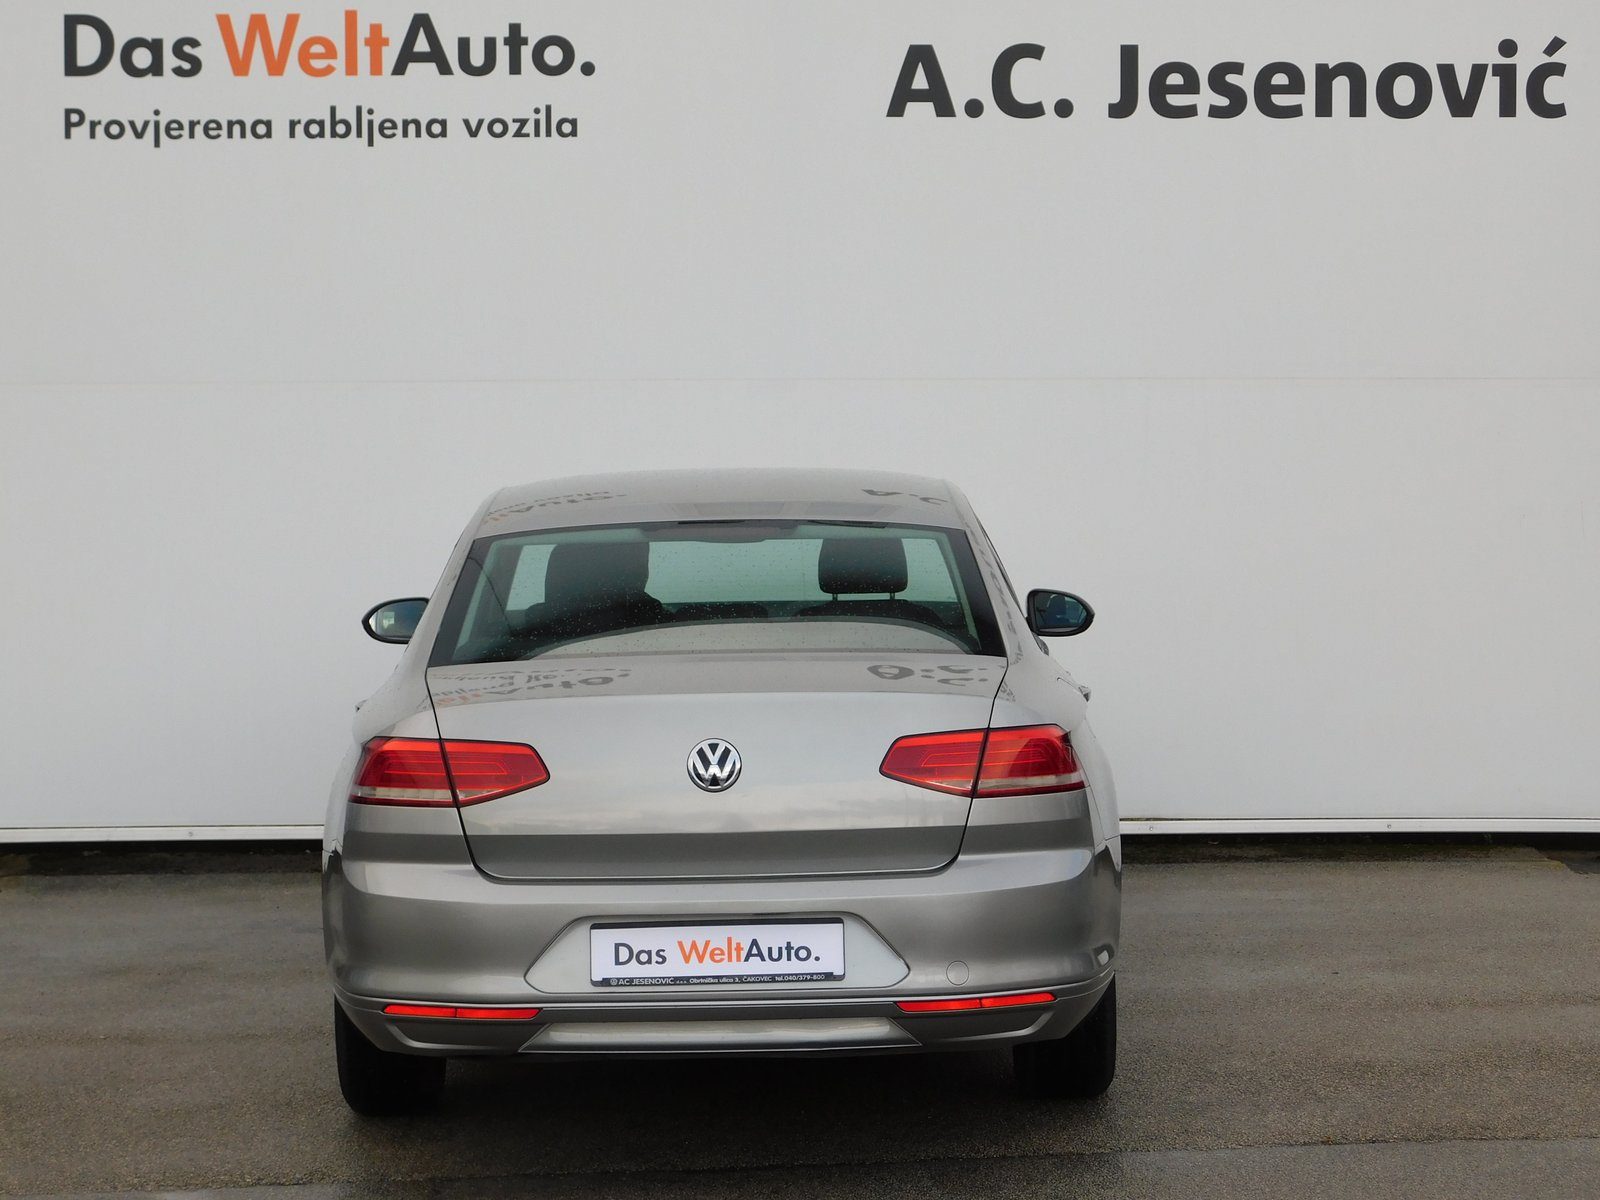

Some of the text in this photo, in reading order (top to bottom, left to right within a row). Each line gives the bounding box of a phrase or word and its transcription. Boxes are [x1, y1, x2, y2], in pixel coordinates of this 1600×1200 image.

[63, 10, 597, 78] Das WeltAuto.
[886, 35, 1568, 120] A.C. Jesenović
[64, 104, 579, 149] Provjerena rabljena vozila
[614, 936, 821, 966] Das WeltAuto.
[618, 978, 630, 986] AC
[632, 977, 675, 985] JESENOVIĆ
[719, 976, 734, 984] ulica
[742, 975, 773, 983] ČAKOVEC
